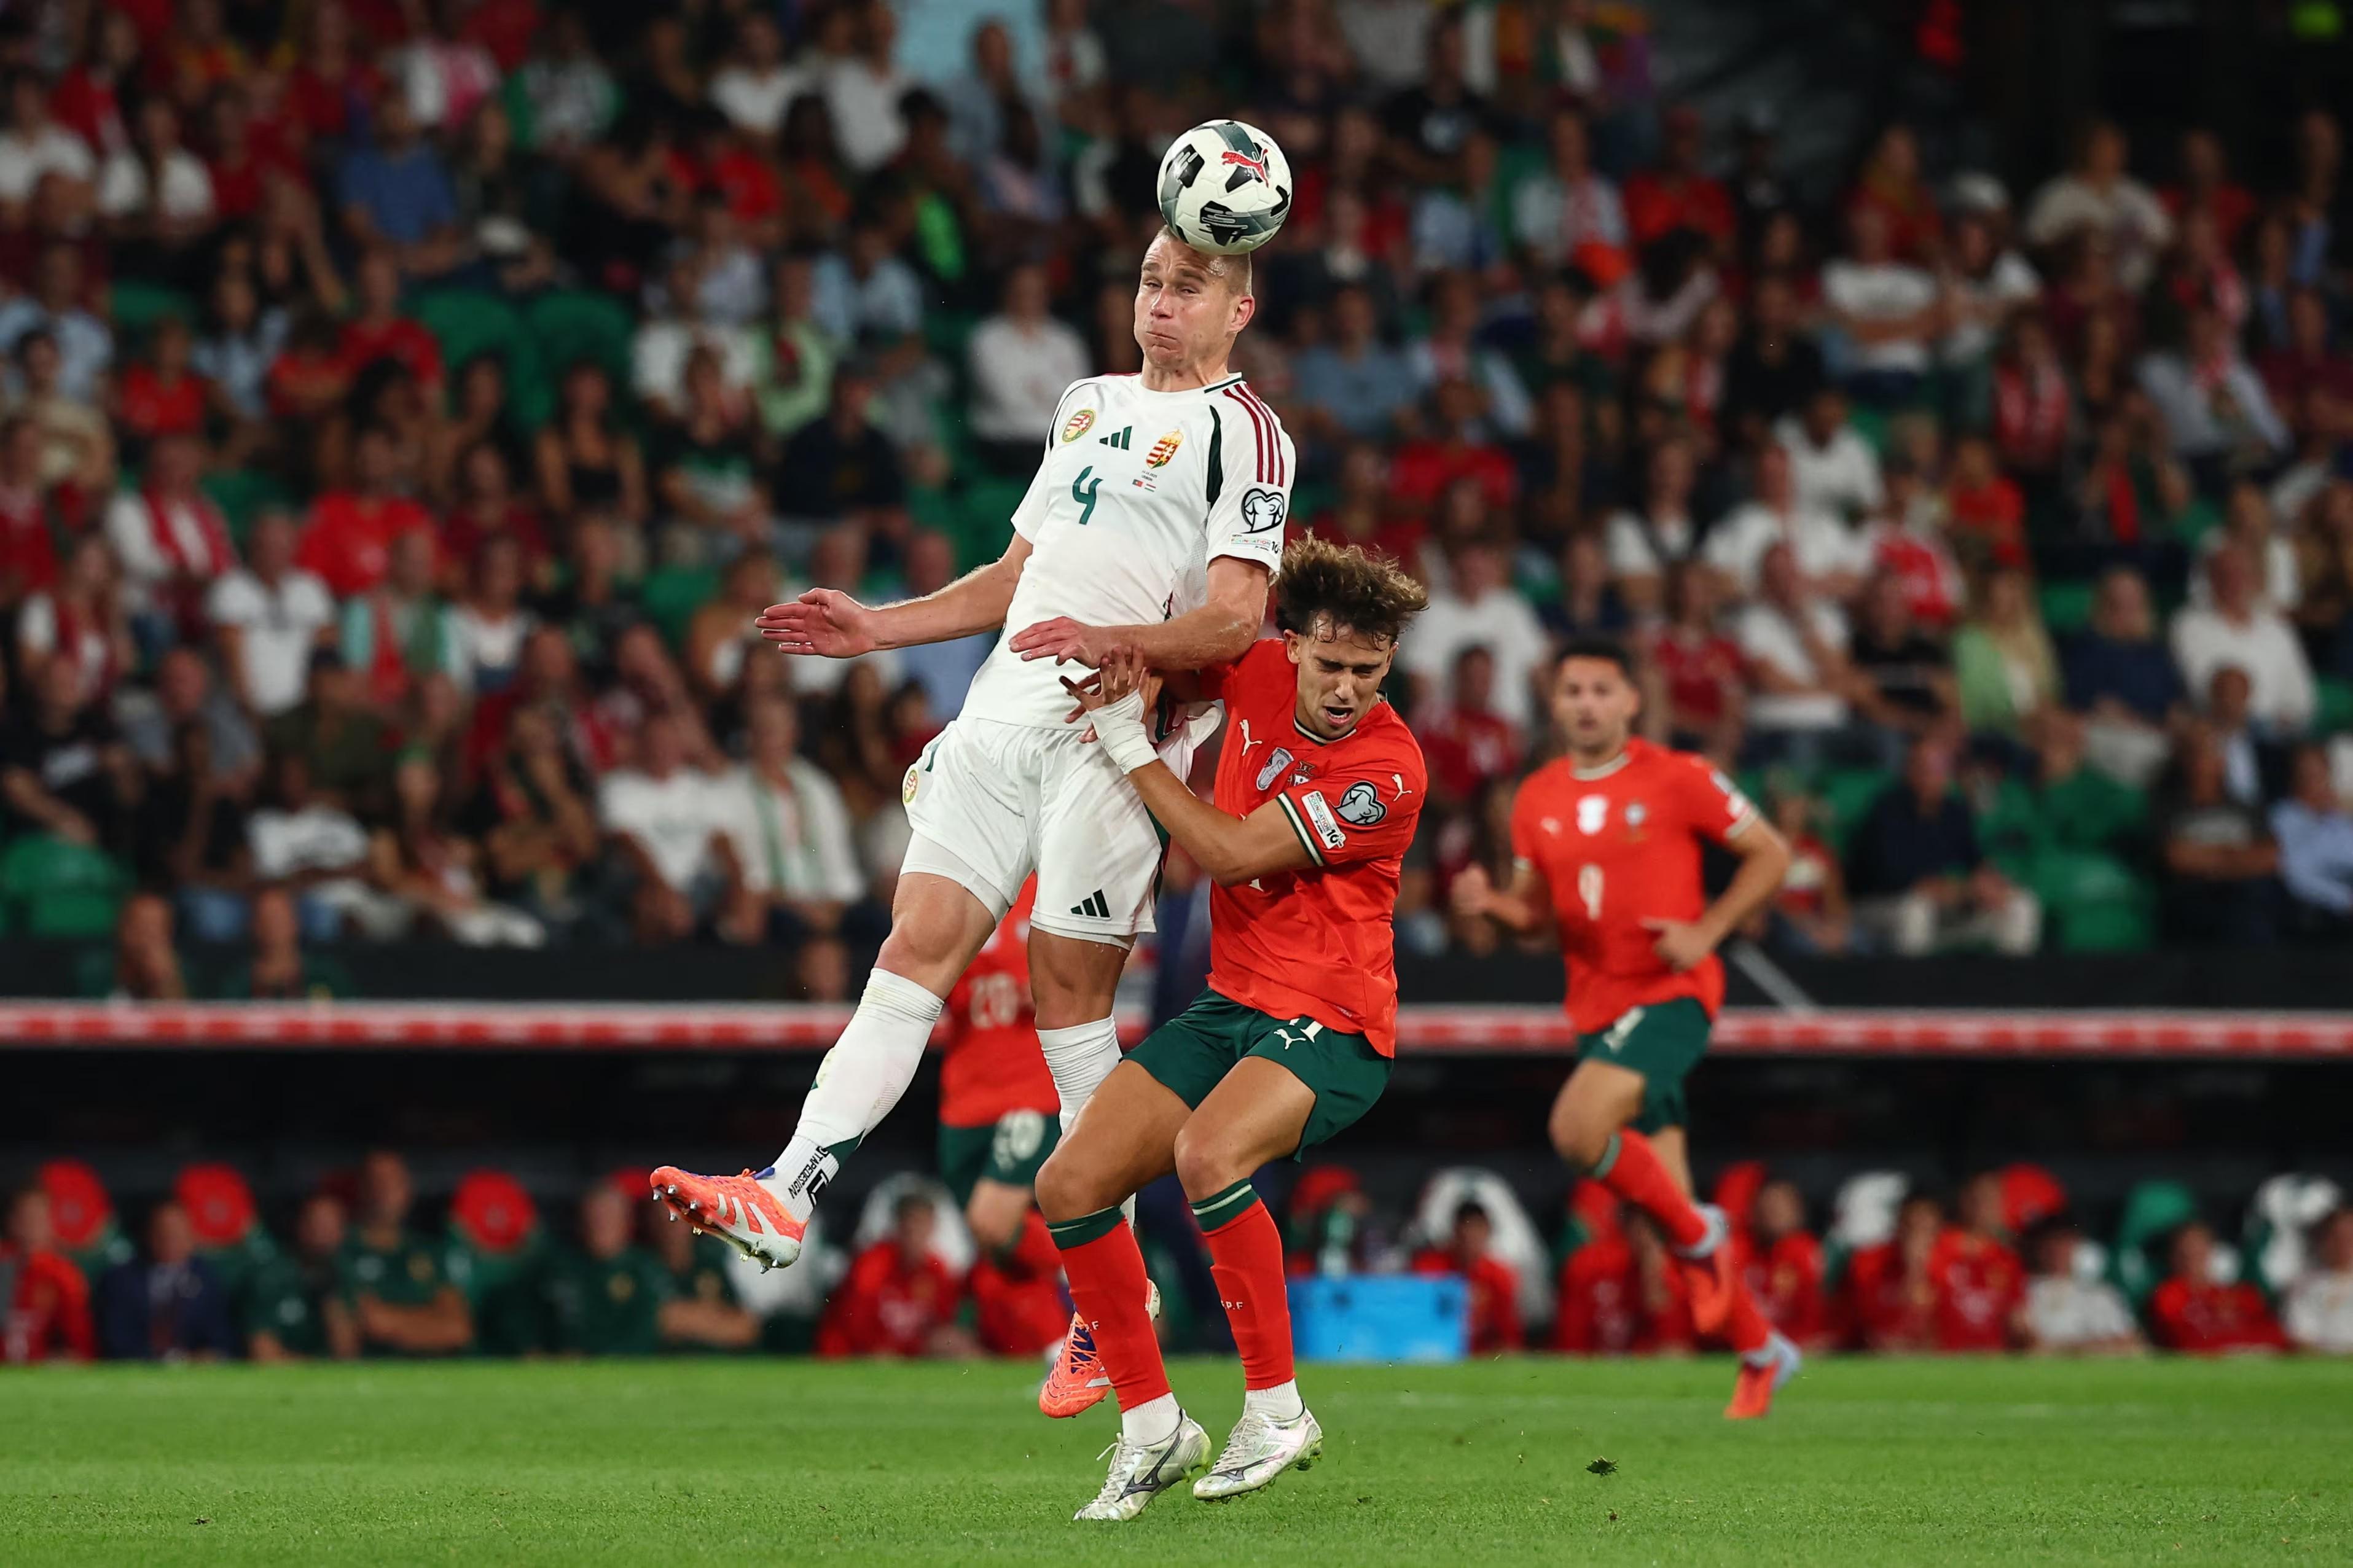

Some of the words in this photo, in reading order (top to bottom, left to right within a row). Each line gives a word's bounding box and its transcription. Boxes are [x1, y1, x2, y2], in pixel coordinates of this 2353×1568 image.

[1072, 466, 1103, 525] 4
[1310, 795, 1331, 832] FOUNDATION
[1577, 864, 1604, 920] 9
[970, 972, 1019, 1029] 20
[788, 1153, 823, 1199] TAPEDESIGN
